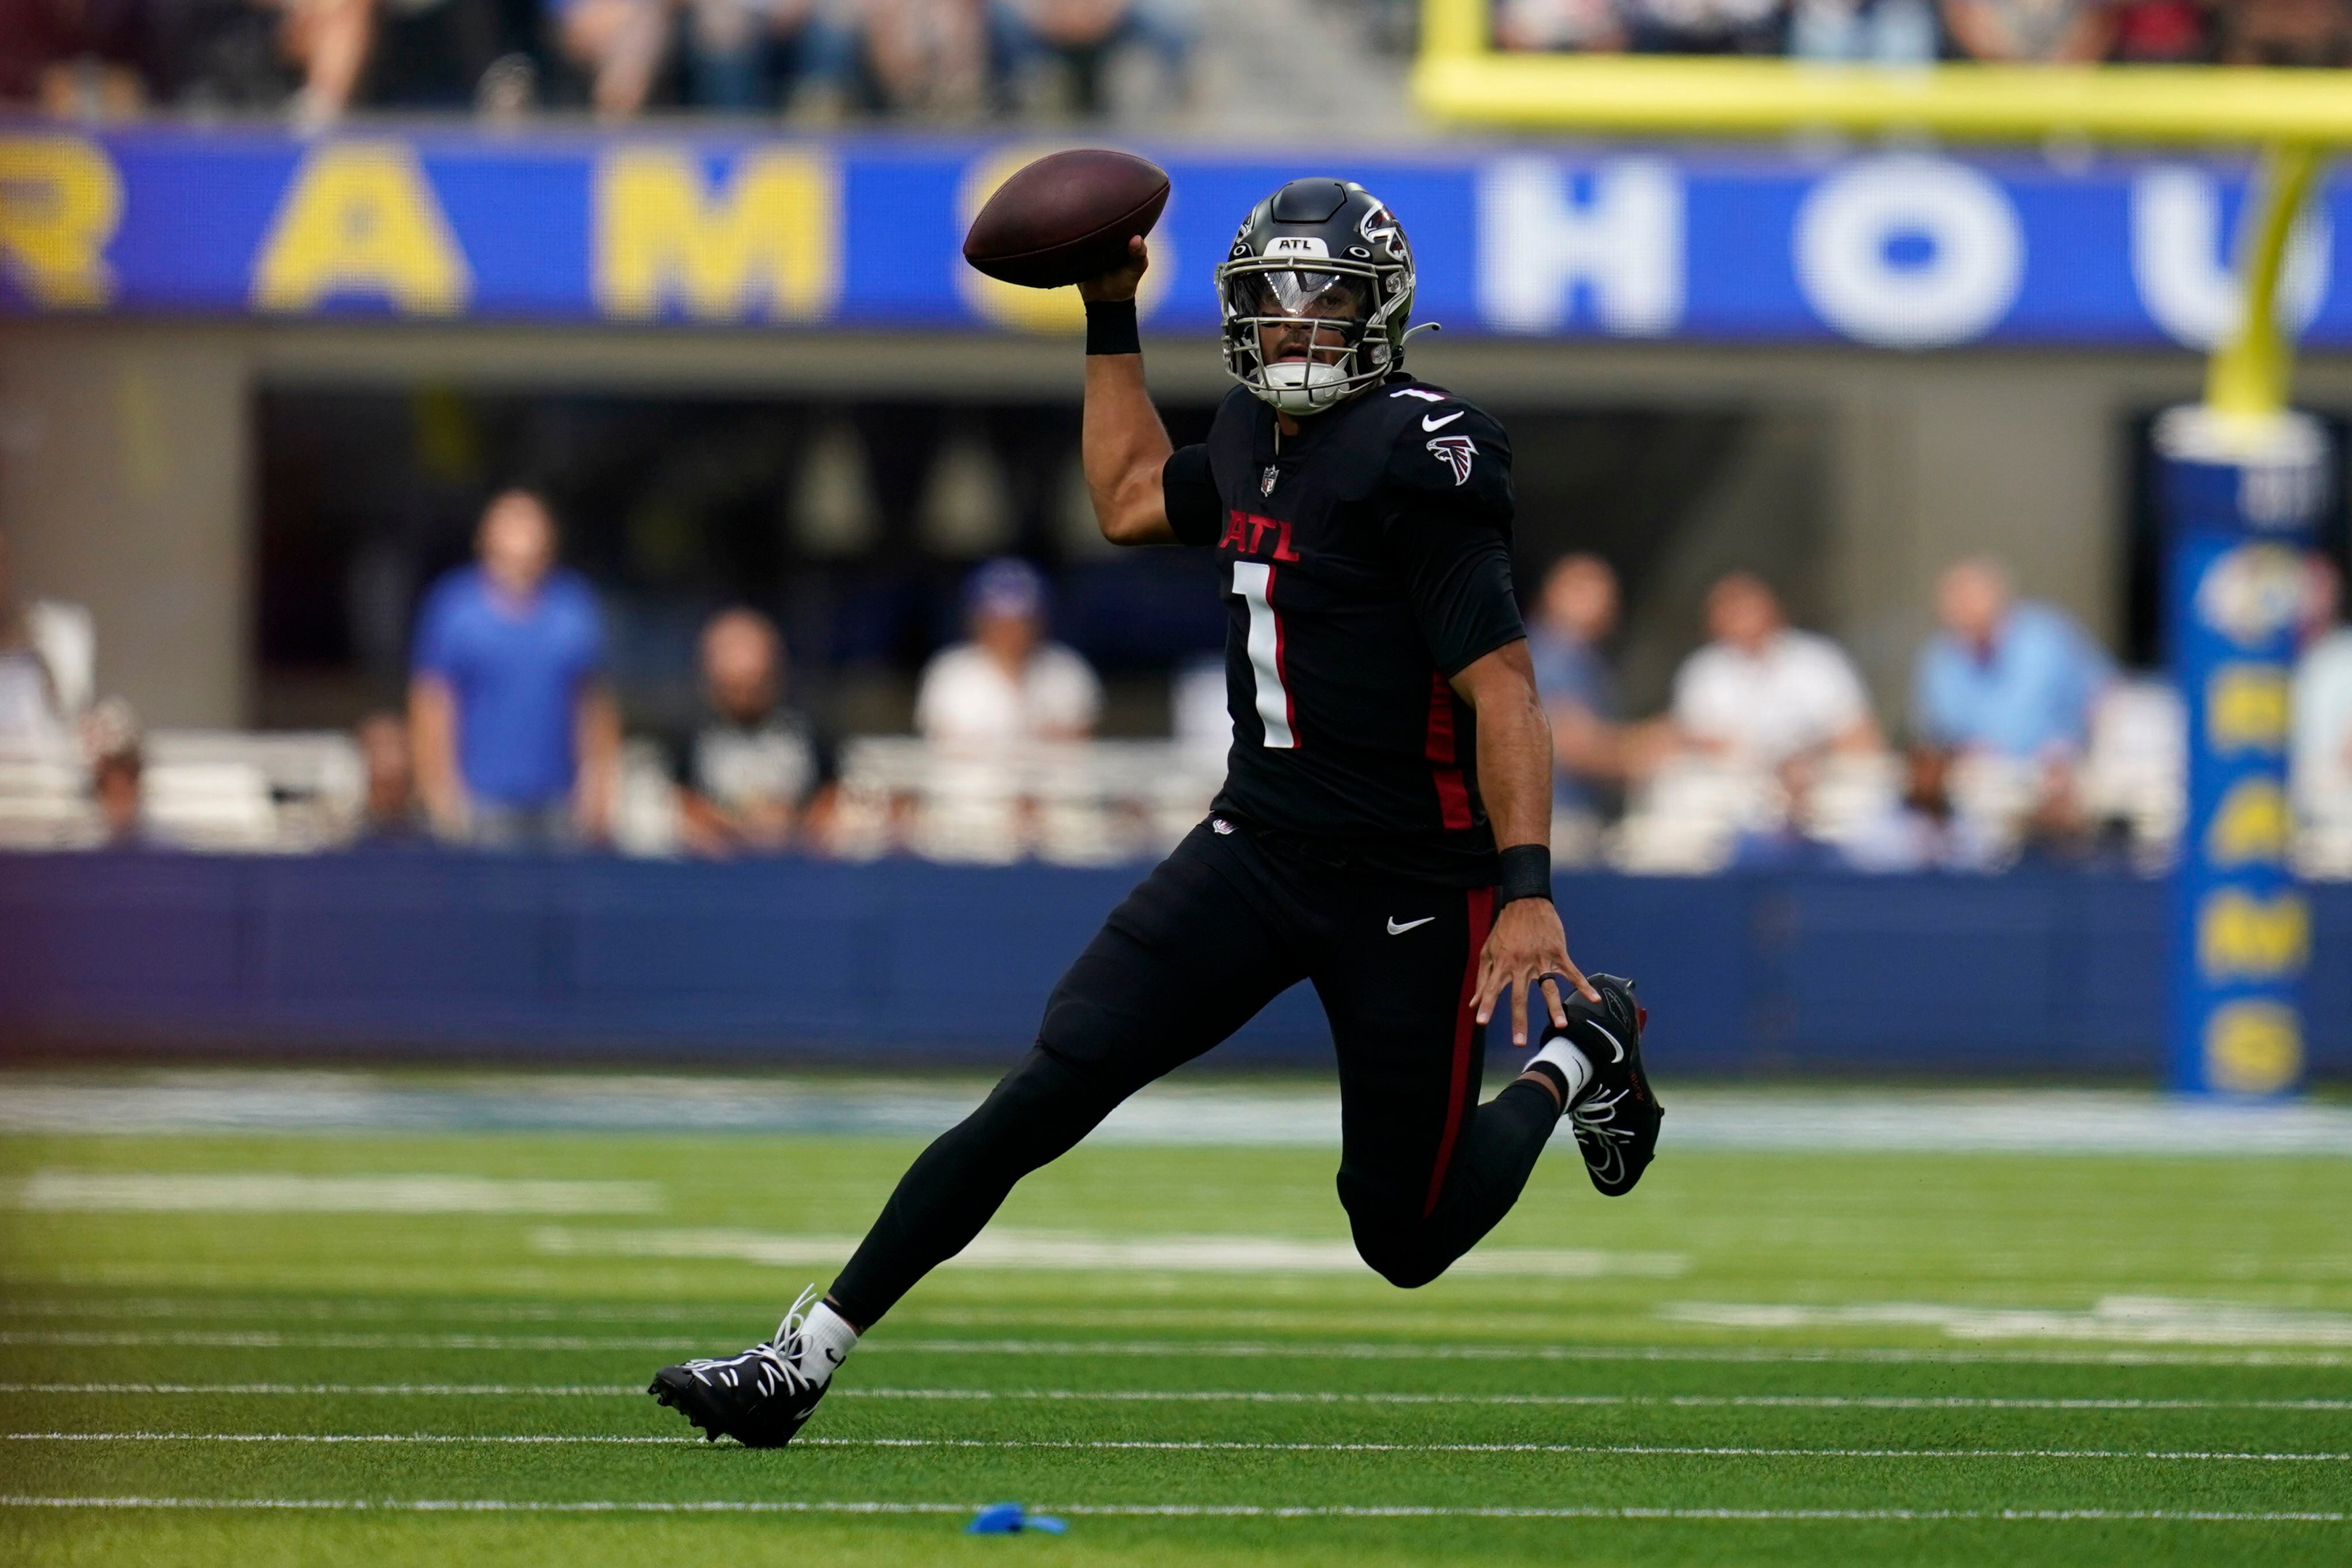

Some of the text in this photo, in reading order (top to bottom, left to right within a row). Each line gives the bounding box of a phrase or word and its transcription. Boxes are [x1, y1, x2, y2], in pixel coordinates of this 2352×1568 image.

[1278, 239, 1312, 250] ATL
[1219, 510, 1300, 562] ATL
[1231, 560, 1301, 748] 1
